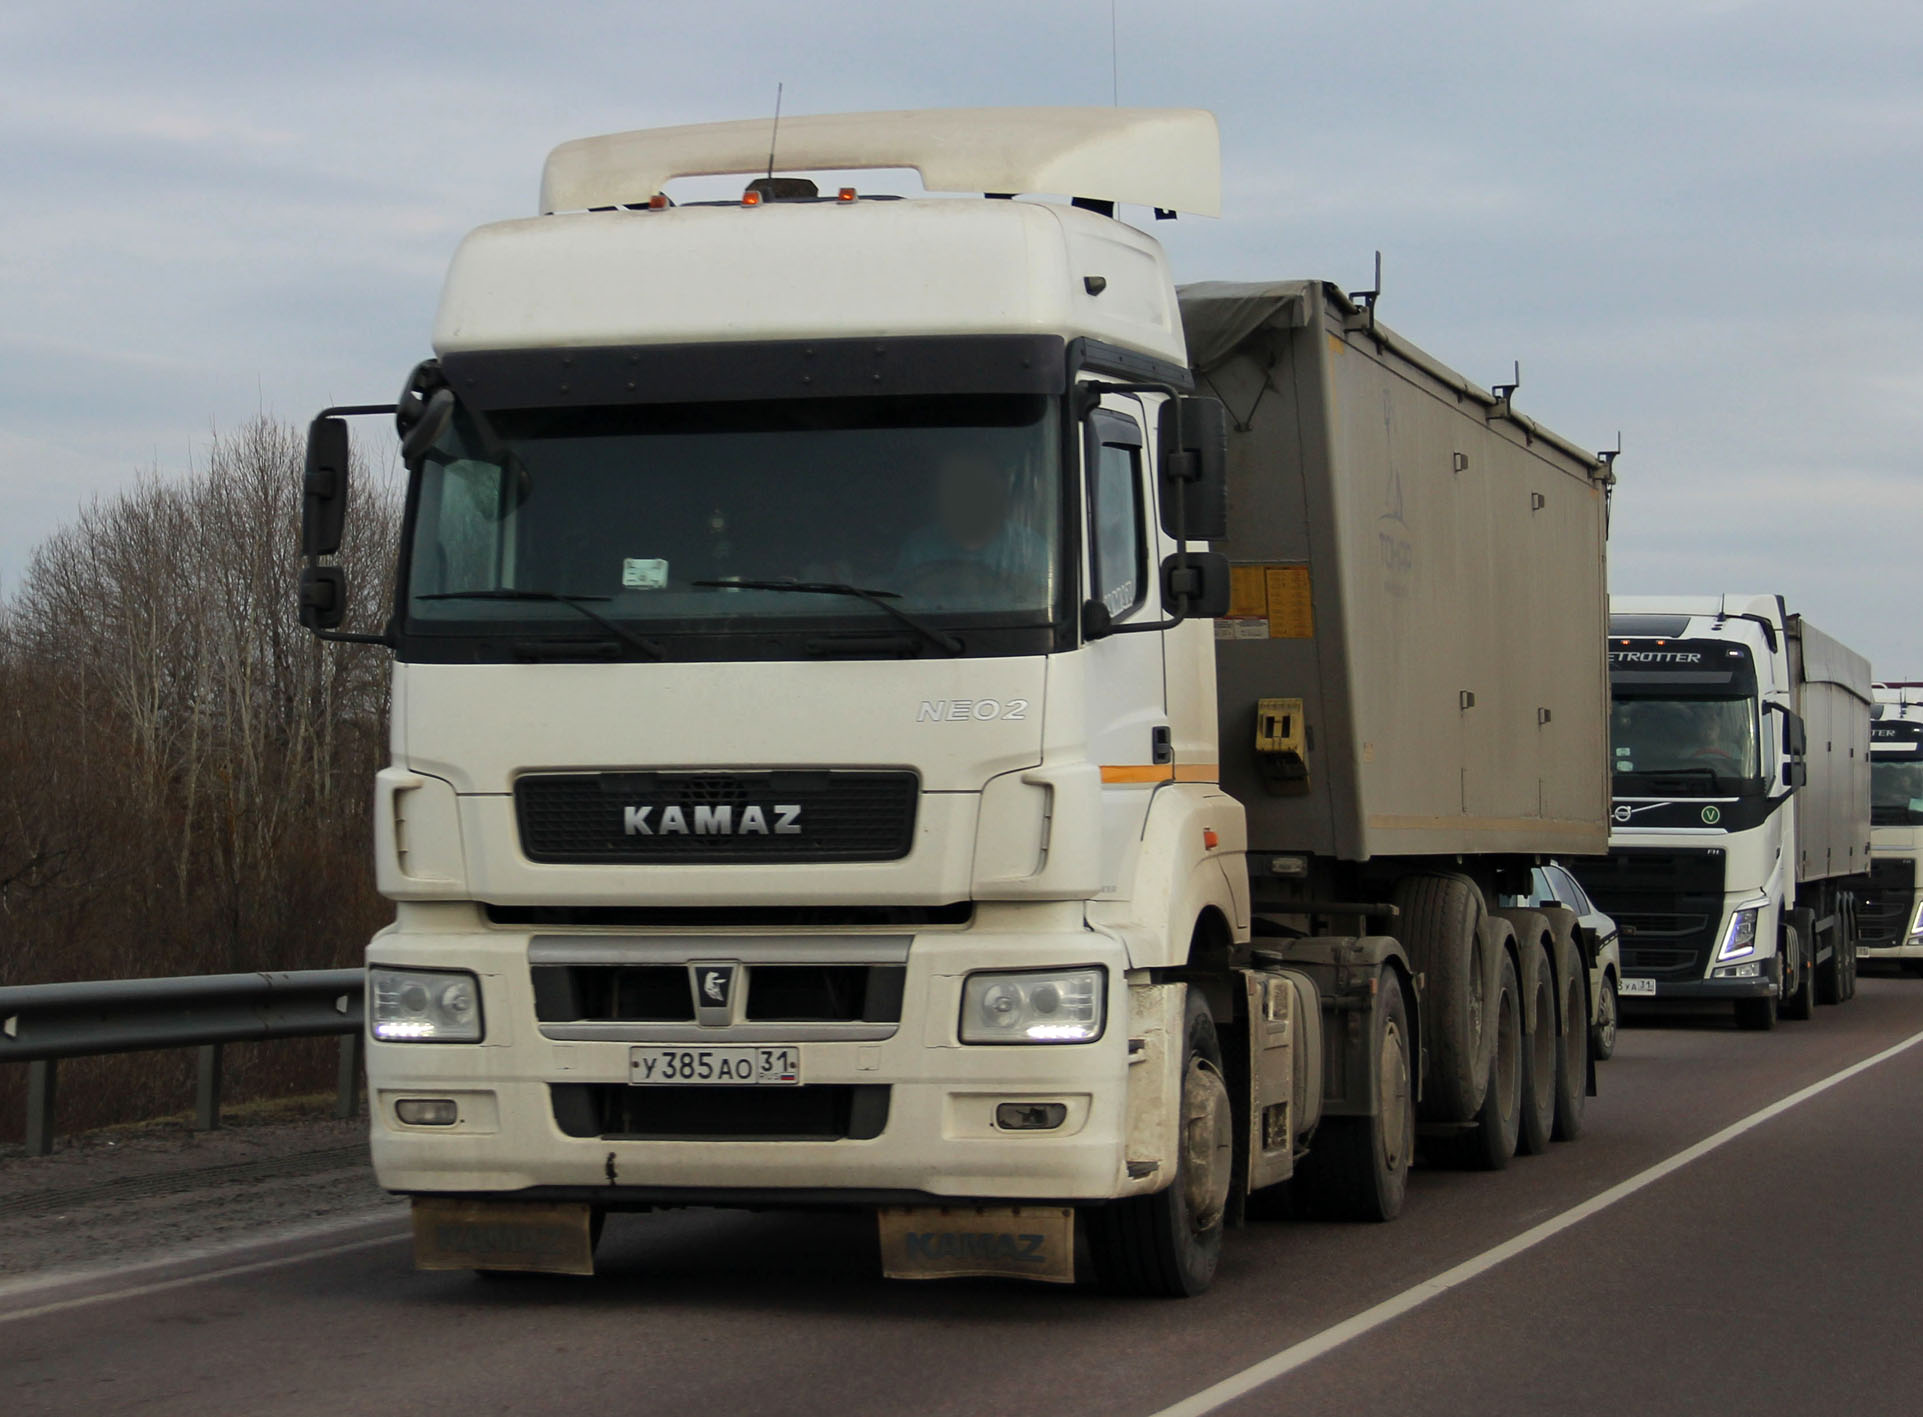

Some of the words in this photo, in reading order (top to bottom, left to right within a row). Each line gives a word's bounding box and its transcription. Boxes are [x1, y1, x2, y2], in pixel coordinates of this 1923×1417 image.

[916, 698, 1030, 722] NEO2
[624, 805, 802, 836] KAMAZ
[761, 1051, 788, 1073] 31
[906, 1231, 1046, 1262] KAMAZ
